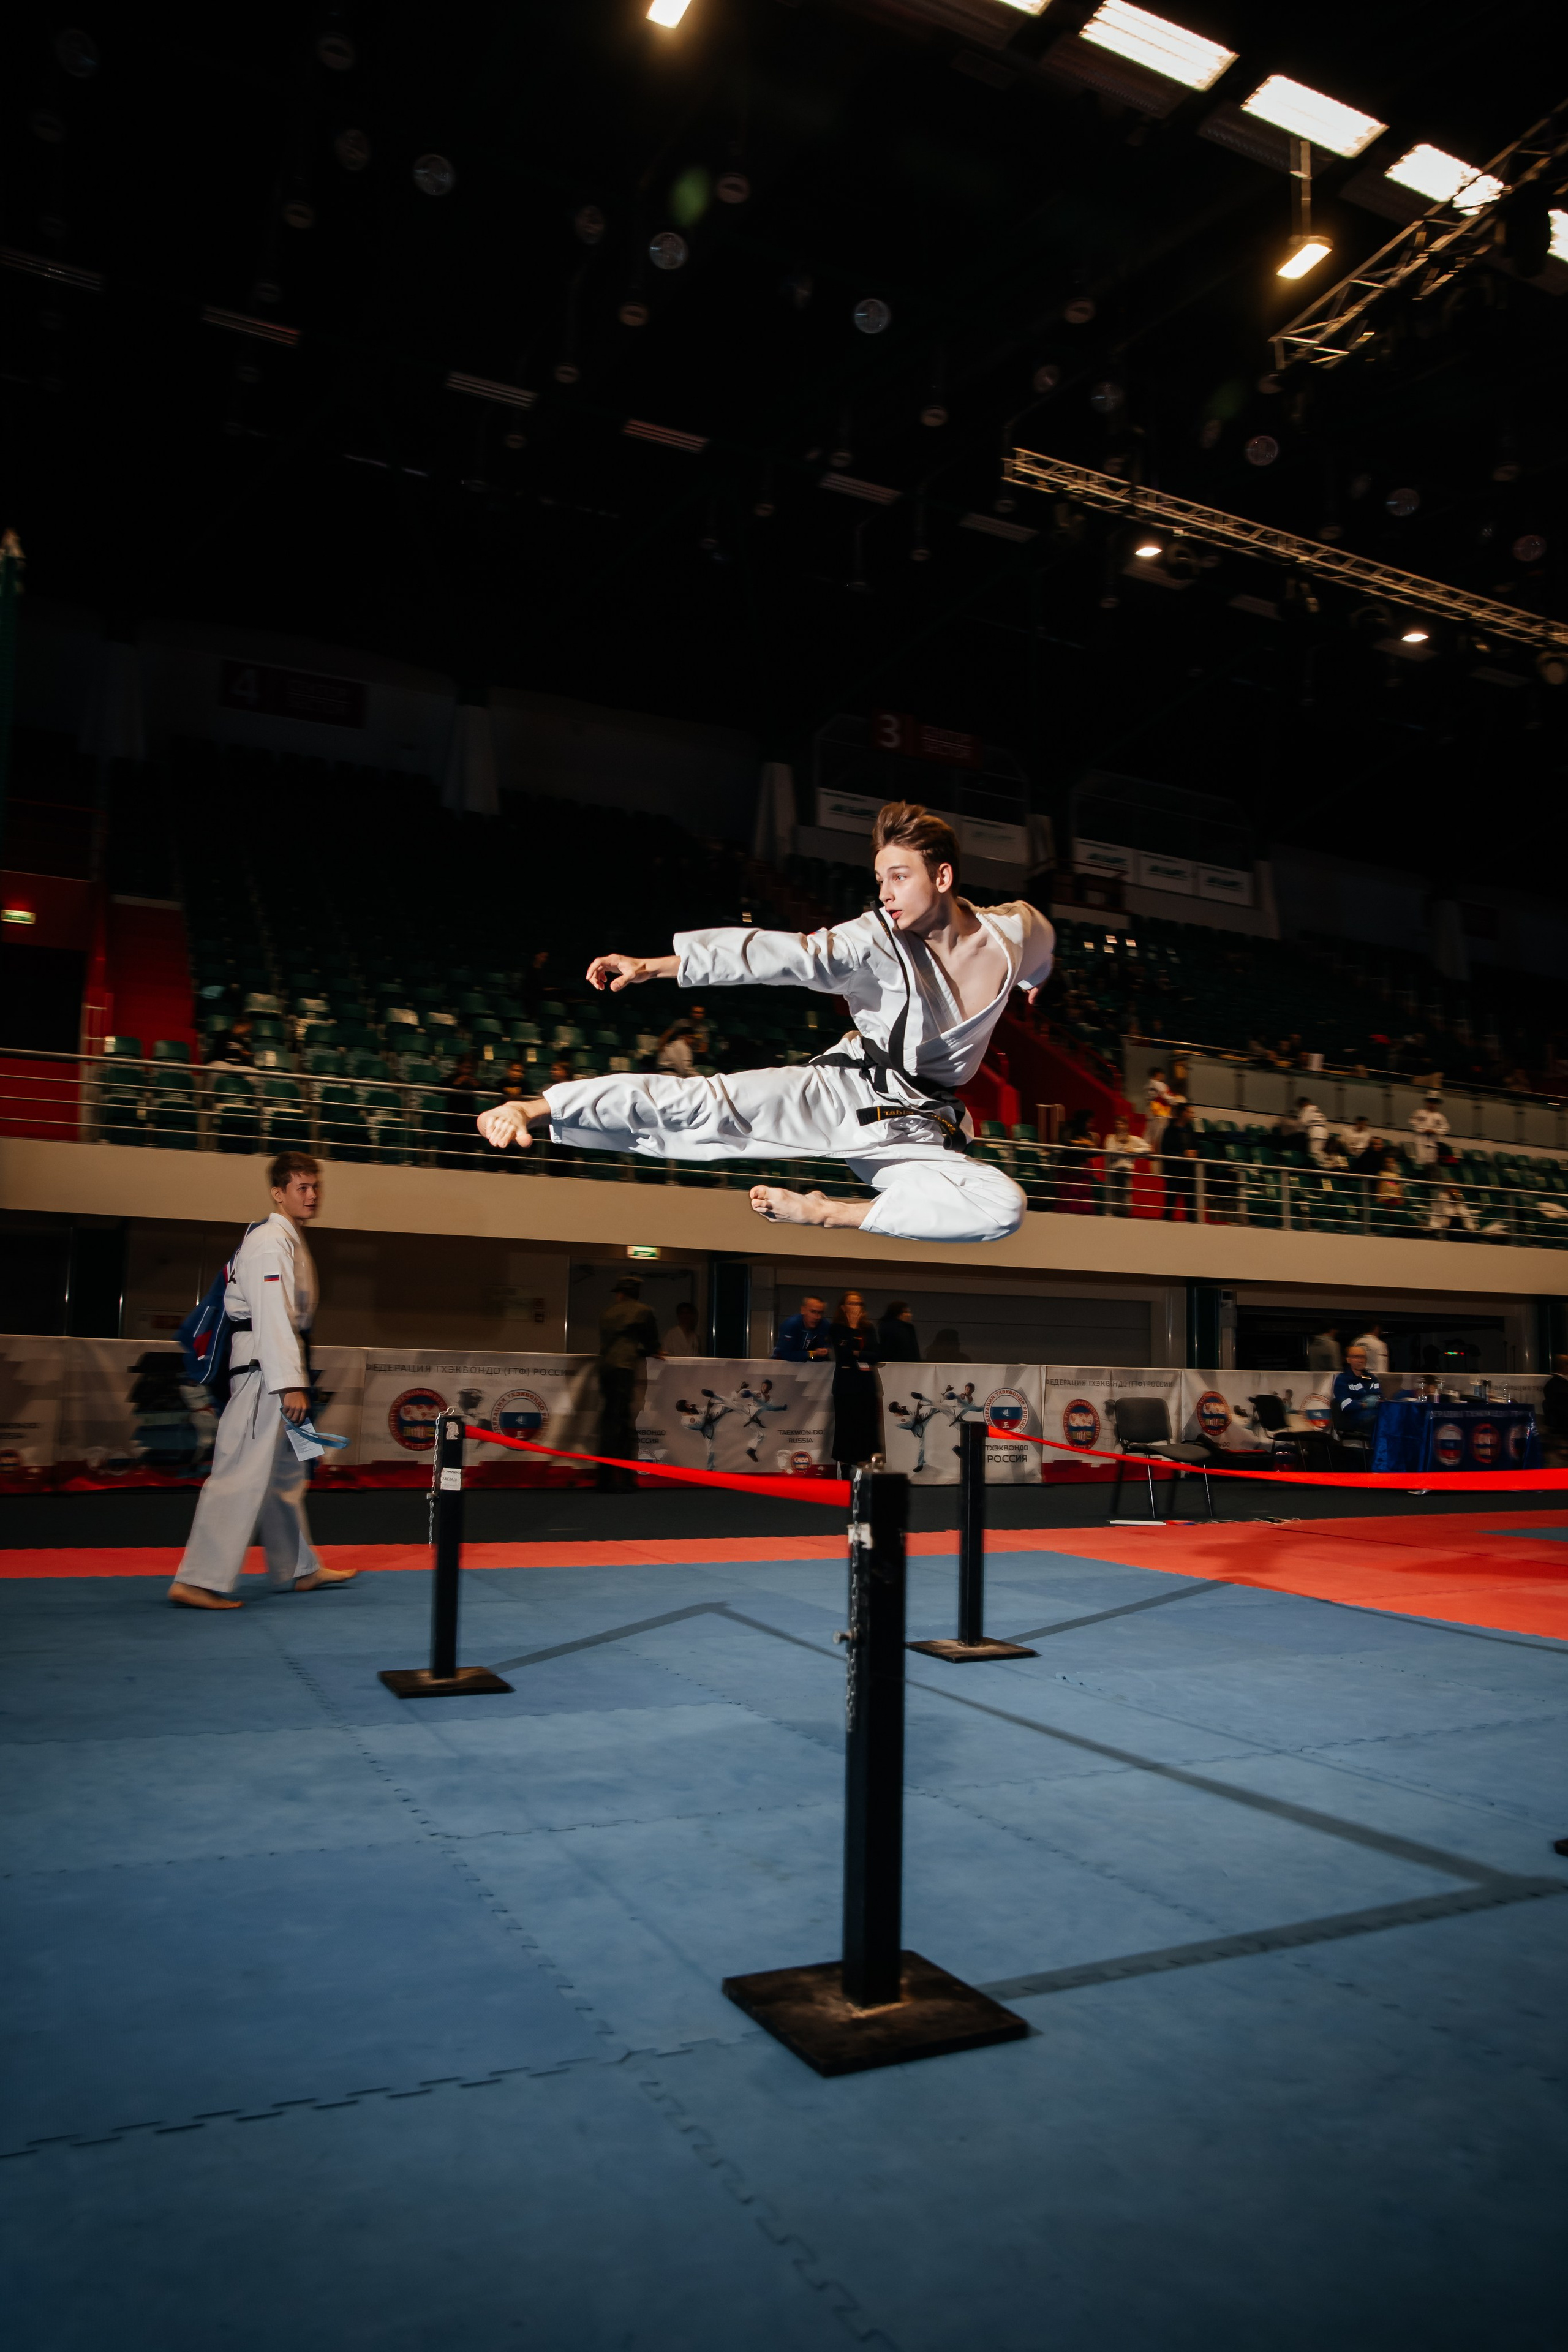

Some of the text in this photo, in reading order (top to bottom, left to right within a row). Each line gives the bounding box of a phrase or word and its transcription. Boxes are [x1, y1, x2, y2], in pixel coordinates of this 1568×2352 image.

[230, 669, 258, 707] 4
[878, 714, 902, 748] 3
[435, 1365, 500, 1376] ТХЭКВОНДО
[503, 1366, 530, 1377] (ГТФ)
[533, 1368, 573, 1376] РОССИ
[506, 1392, 545, 1411] ТХЭКВОНДО
[985, 1395, 996, 1425] ЕДЕРАЦИЯ
[995, 1390, 1025, 1405] ТХЭКВОНДО
[987, 1455, 1028, 1464] РОССИЯ
